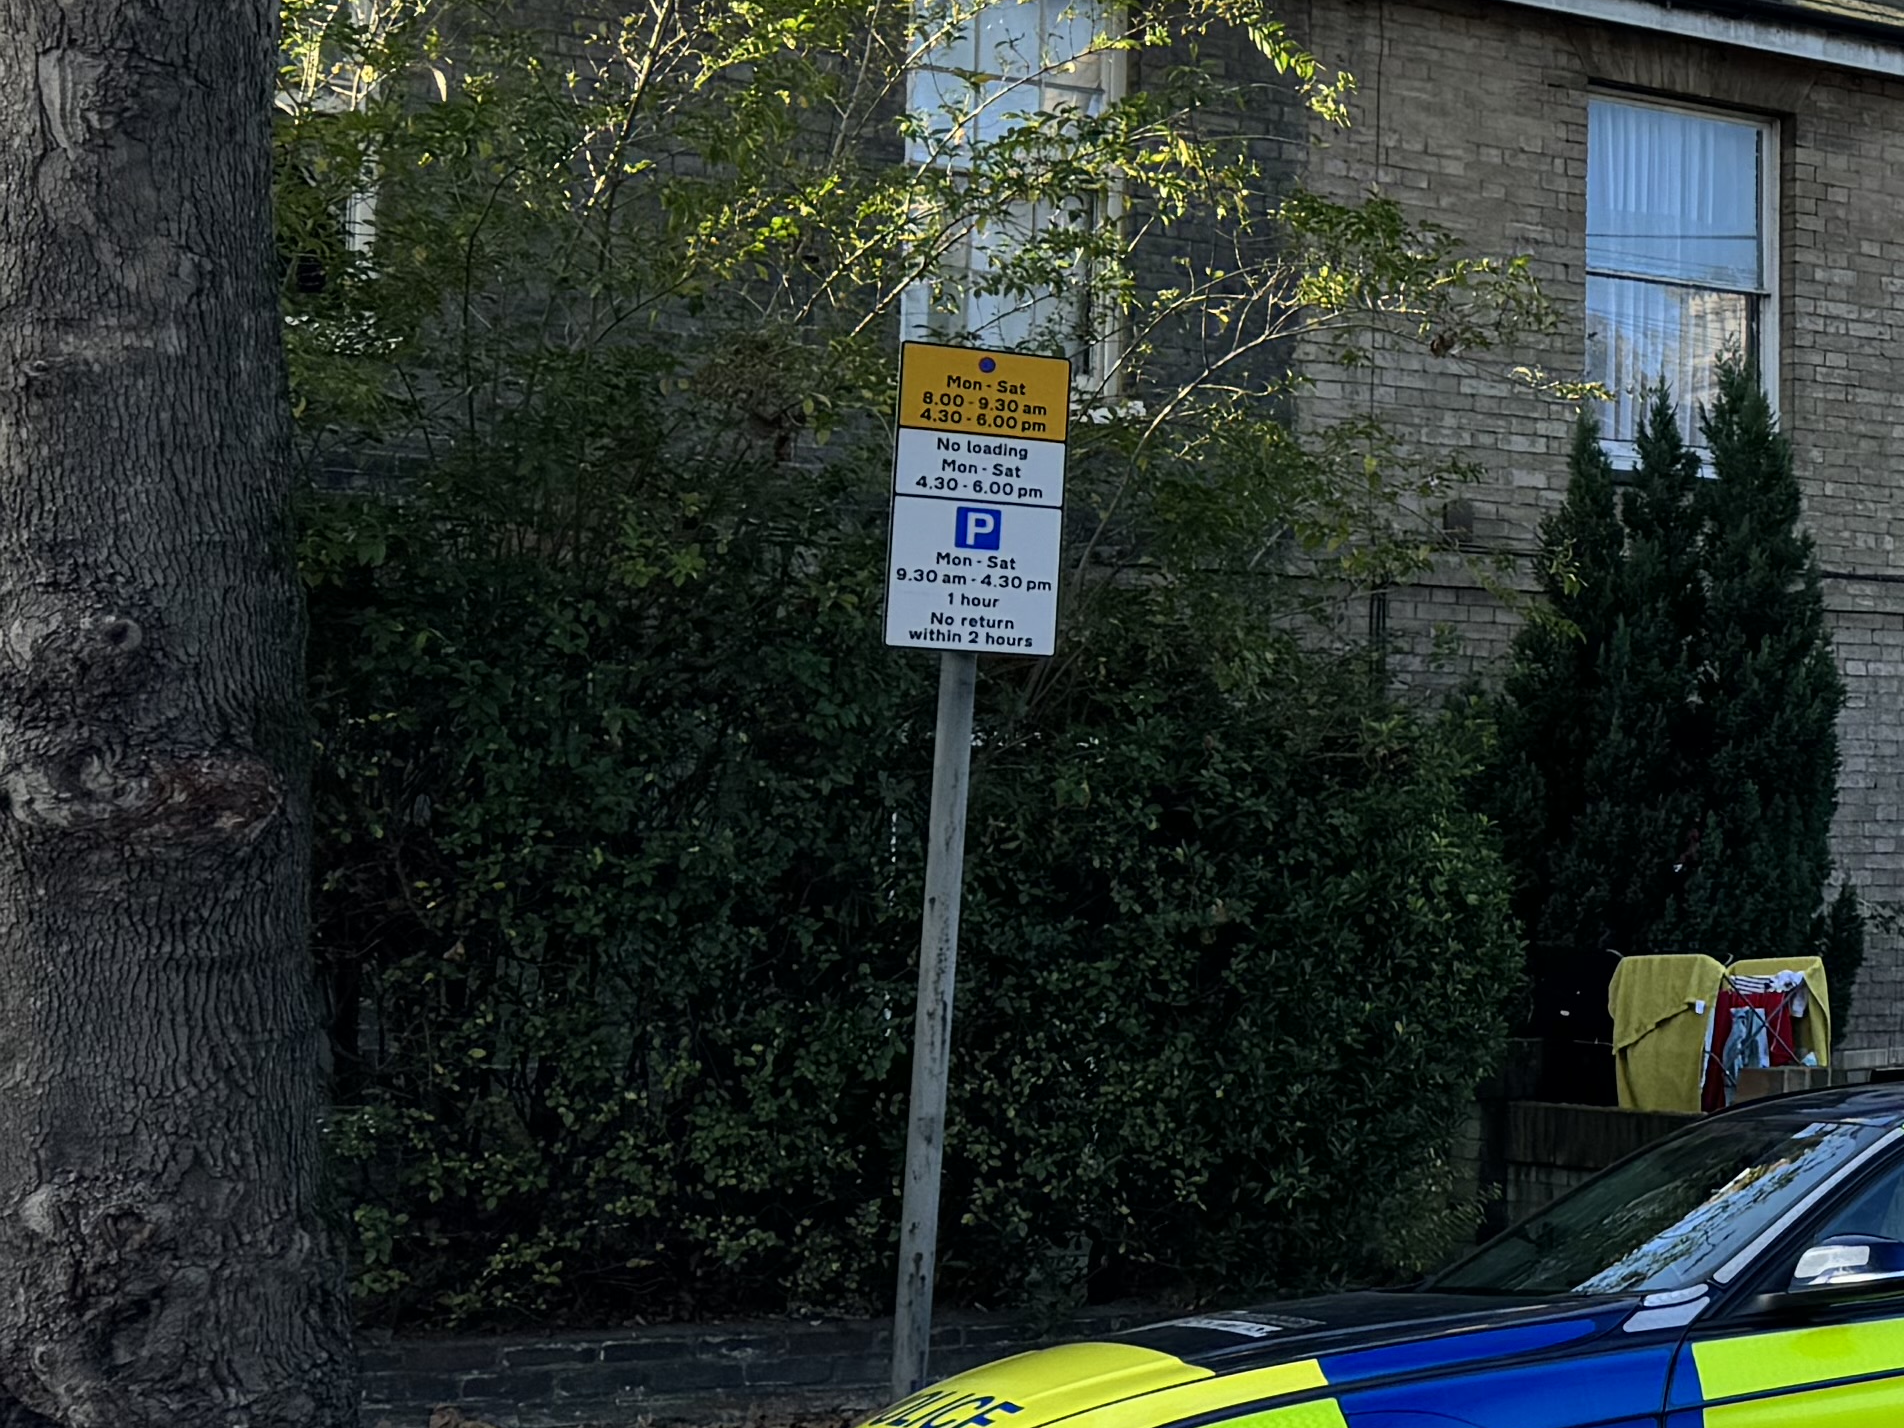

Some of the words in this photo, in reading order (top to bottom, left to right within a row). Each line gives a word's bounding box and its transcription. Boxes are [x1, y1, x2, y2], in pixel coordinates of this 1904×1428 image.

[947, 375, 981, 391] Mon
[997, 380, 1026, 396] Sat
[923, 393, 964, 408] 8.00
[979, 398, 1018, 413] 9.30
[1023, 404, 1047, 416] am
[920, 408, 962, 424] 4.30
[976, 414, 1017, 429] 6.00
[1022, 419, 1046, 433] pm
[937, 438, 960, 452] No
[968, 440, 1028, 460] loading
[942, 459, 977, 474] Mon
[992, 464, 1021, 478] Sat
[916, 476, 958, 491] 4.30
[972, 481, 1013, 496] 6.00
[1018, 486, 1043, 500] pm
[966, 512, 994, 545] P
[937, 552, 971, 566] Mon
[987, 556, 1015, 570] Sat
[897, 569, 937, 583] 9.30
[942, 574, 966, 585] am
[981, 574, 1022, 589] 4.30
[1027, 579, 1051, 592] pm
[948, 592, 954, 605] 1
[961, 593, 999, 608] hour
[931, 612, 954, 626] No
[961, 616, 1014, 630] return
[909, 629, 961, 643] within
[968, 631, 978, 644] 2
[986, 633, 1032, 648] hours
